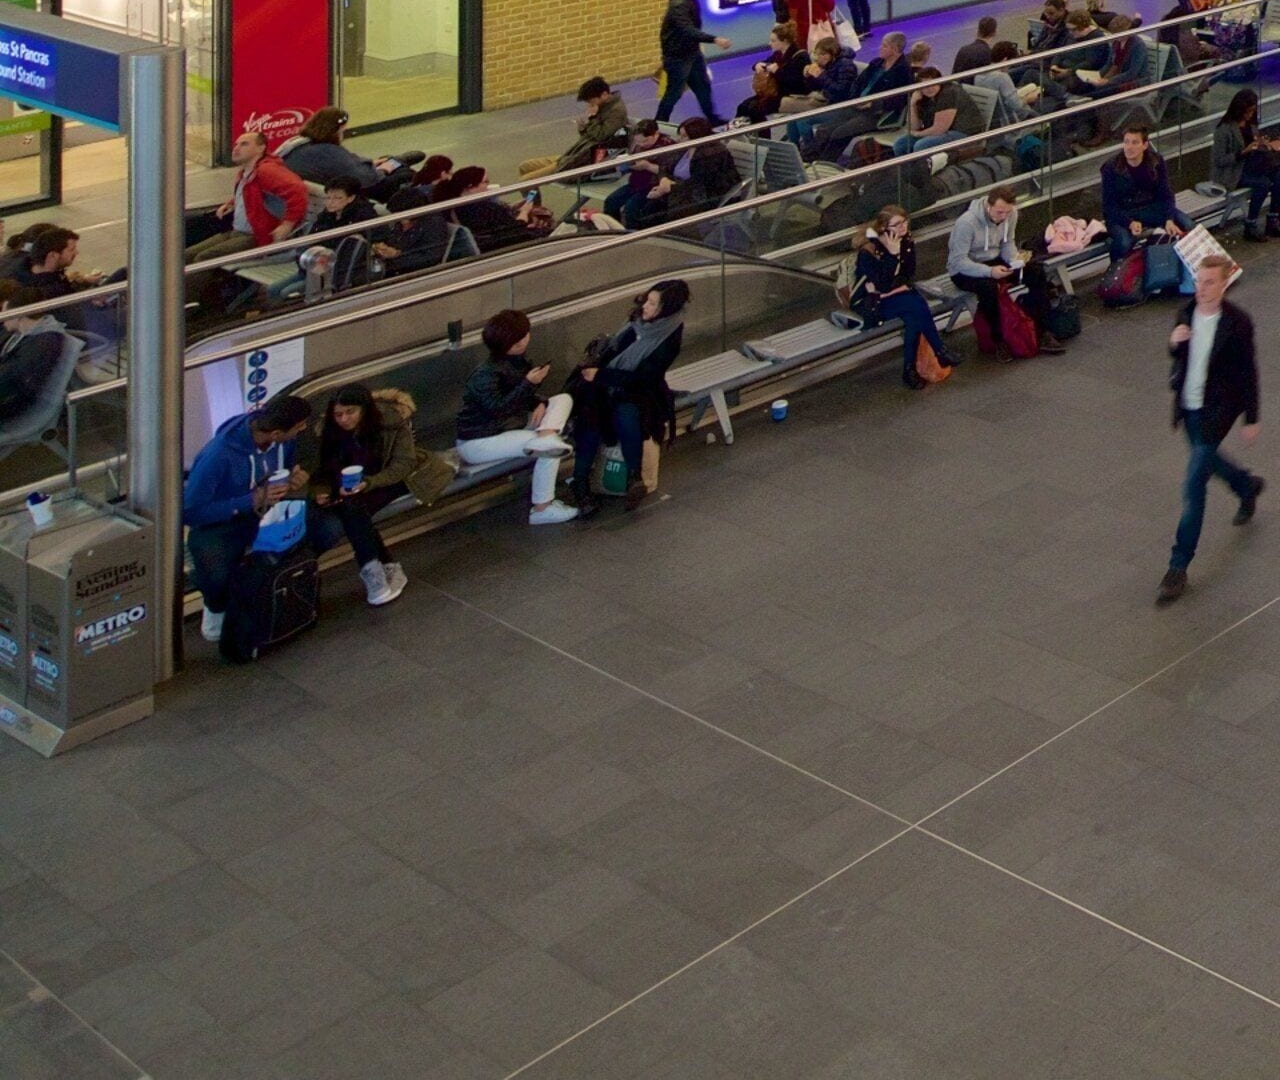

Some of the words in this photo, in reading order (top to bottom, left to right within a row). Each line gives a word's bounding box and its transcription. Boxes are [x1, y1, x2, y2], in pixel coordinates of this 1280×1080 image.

[20, 43, 50, 66] Pancras
[18, 66, 46, 89] Station
[263, 117, 296, 130] trains
[75, 566, 147, 599] Standard
[76, 561, 138, 590] Evening
[78, 606, 146, 643] METRO
